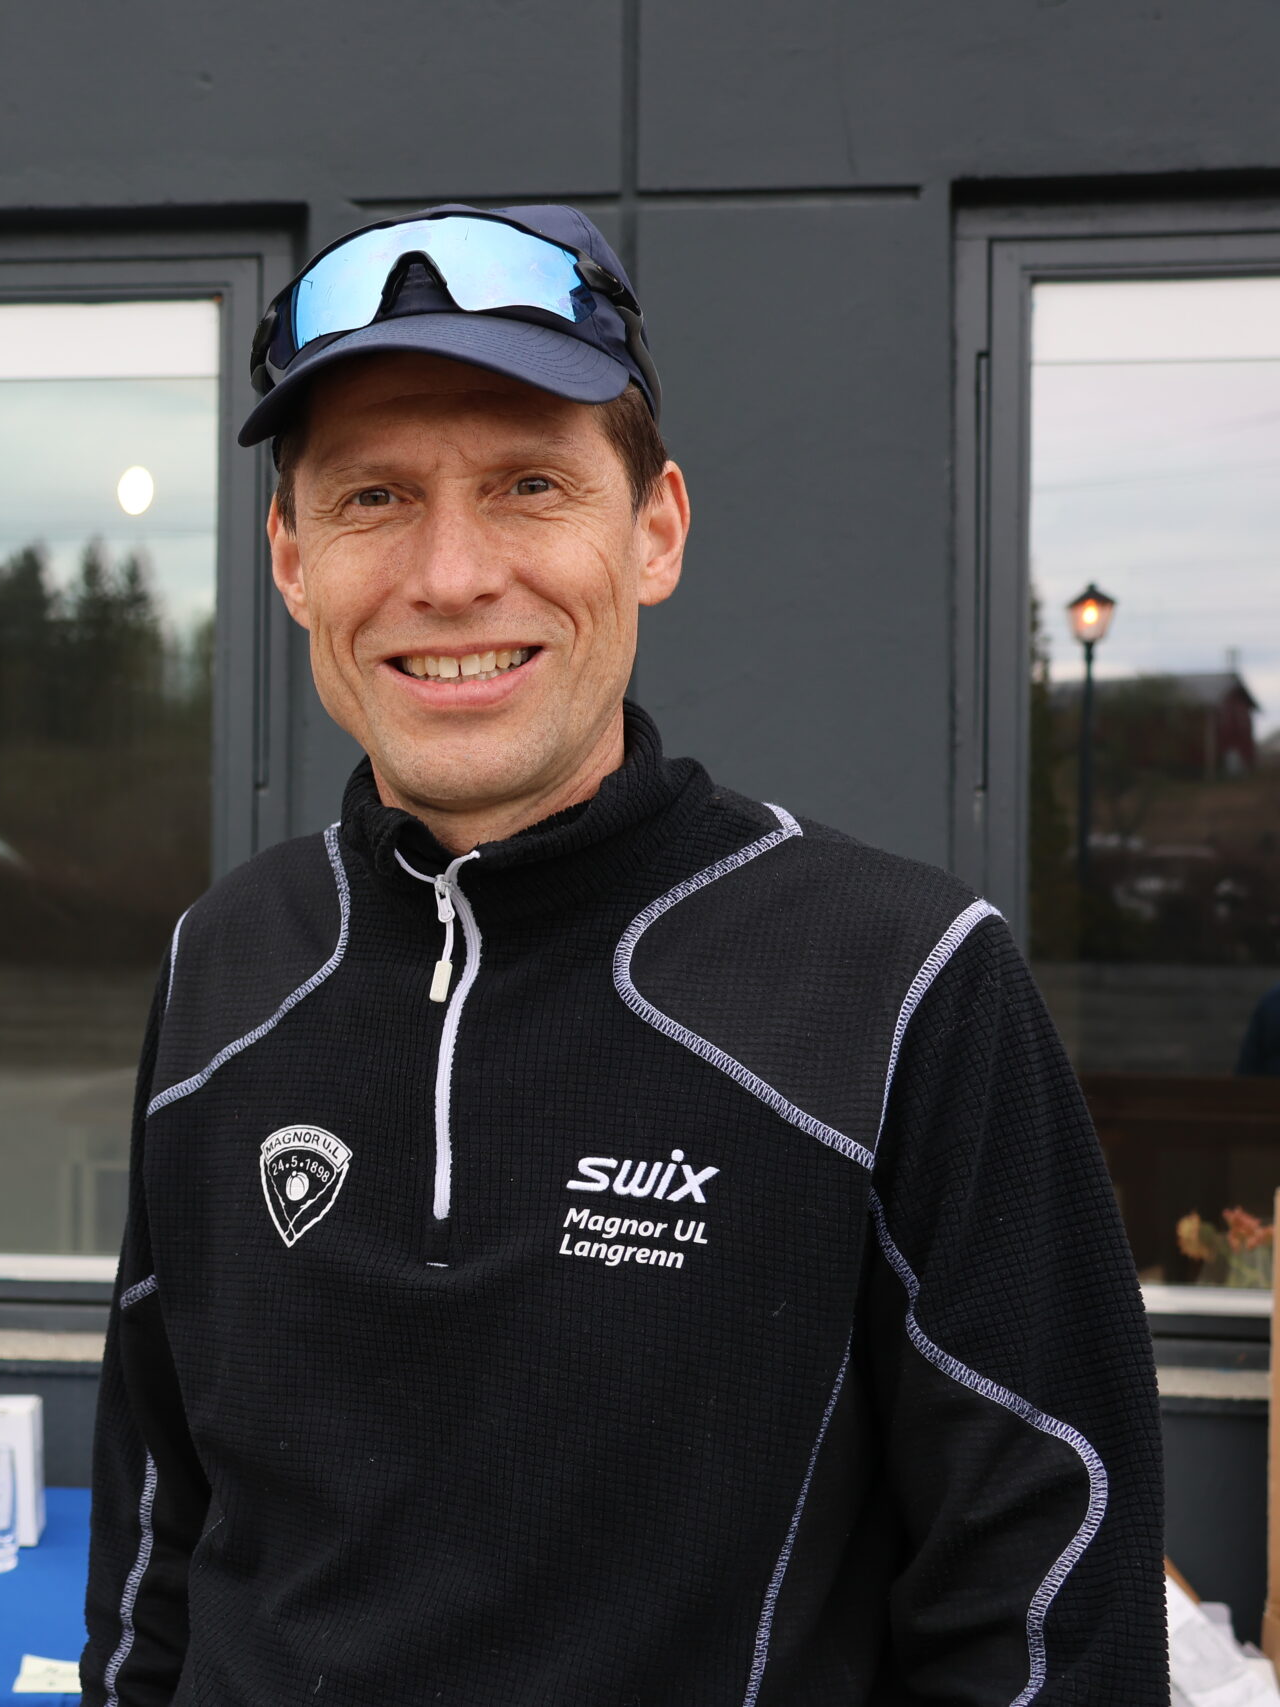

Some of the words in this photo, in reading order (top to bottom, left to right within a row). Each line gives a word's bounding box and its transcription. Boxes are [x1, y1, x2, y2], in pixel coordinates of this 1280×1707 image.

[264, 1130, 321, 1156] MAGNOR
[562, 1207, 669, 1239] Magnor
[673, 1219, 709, 1245] UL
[558, 1233, 686, 1269] Langrenn
